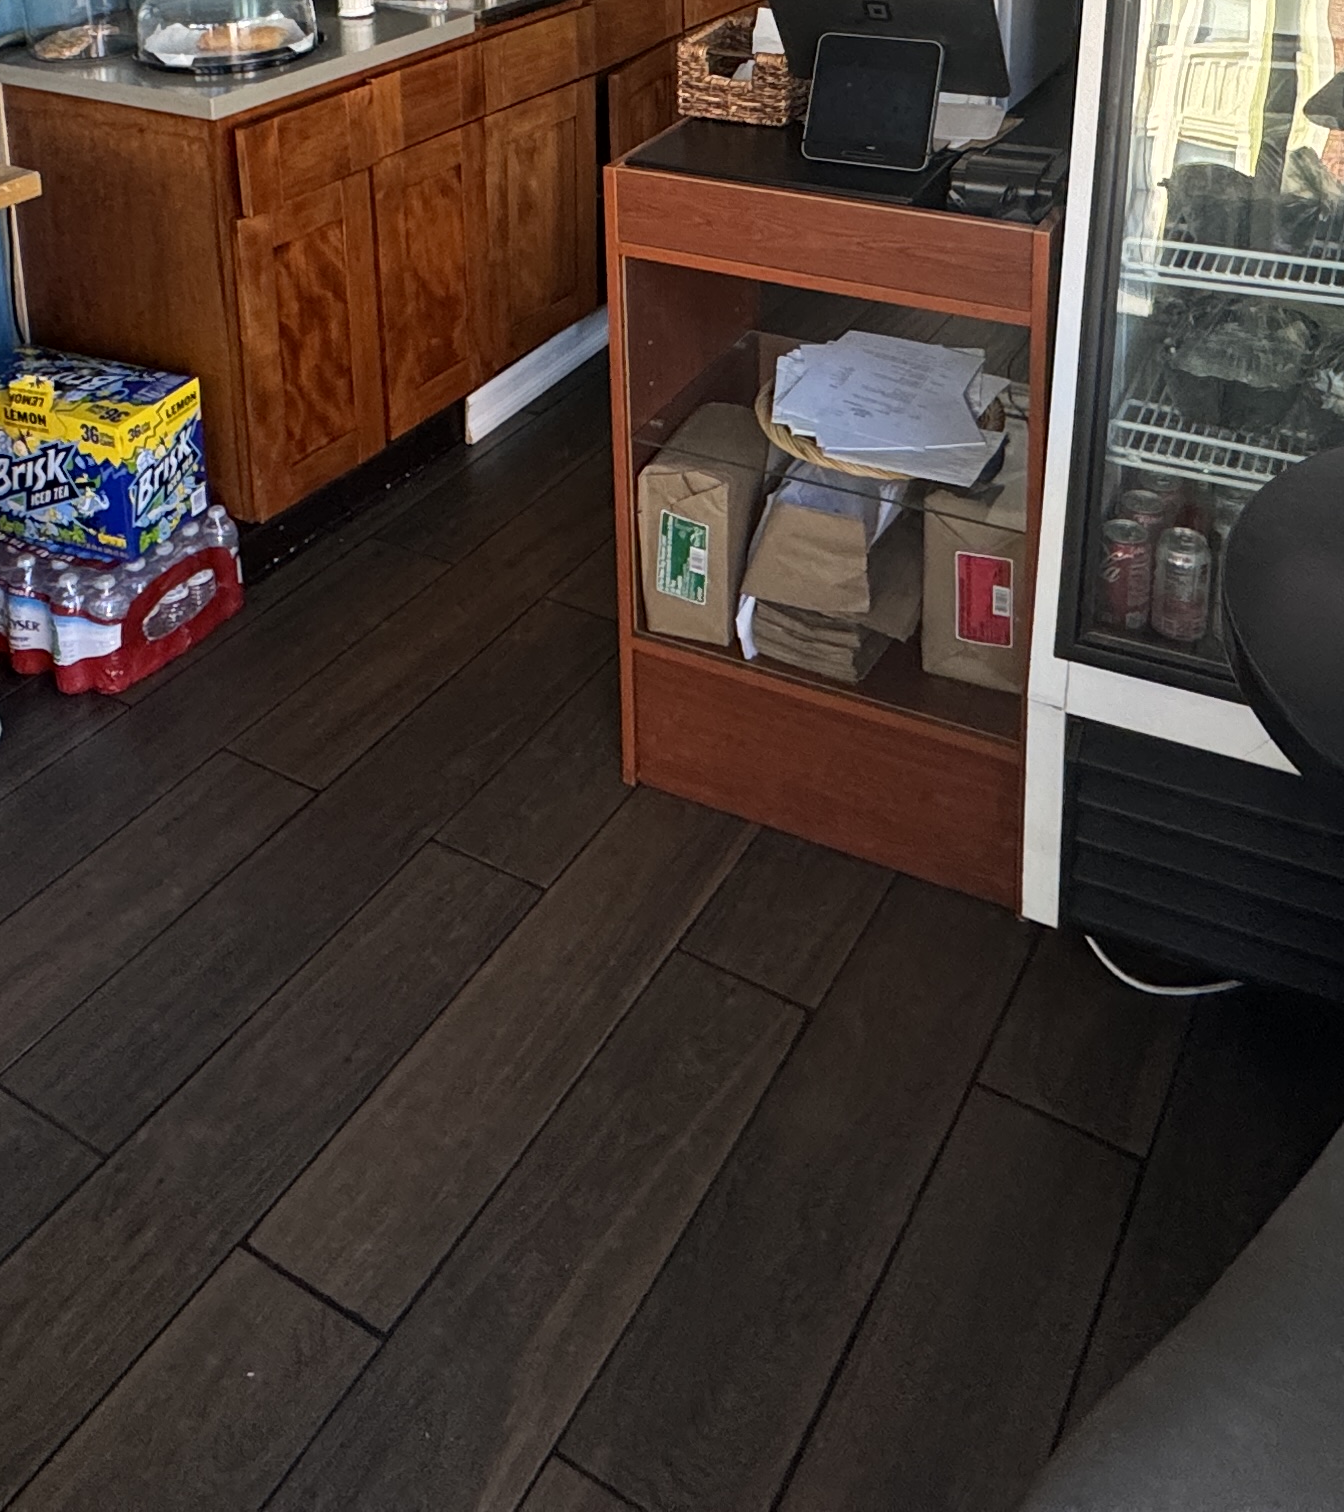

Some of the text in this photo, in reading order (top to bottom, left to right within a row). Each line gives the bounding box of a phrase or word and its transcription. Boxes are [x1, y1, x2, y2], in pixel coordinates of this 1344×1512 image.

[165, 391, 197, 419] LEMON
[4, 406, 47, 427] LEMON
[80, 423, 100, 445] 36
[127, 424, 142, 442] 36
[30, 484, 70, 507] ICED TEA
